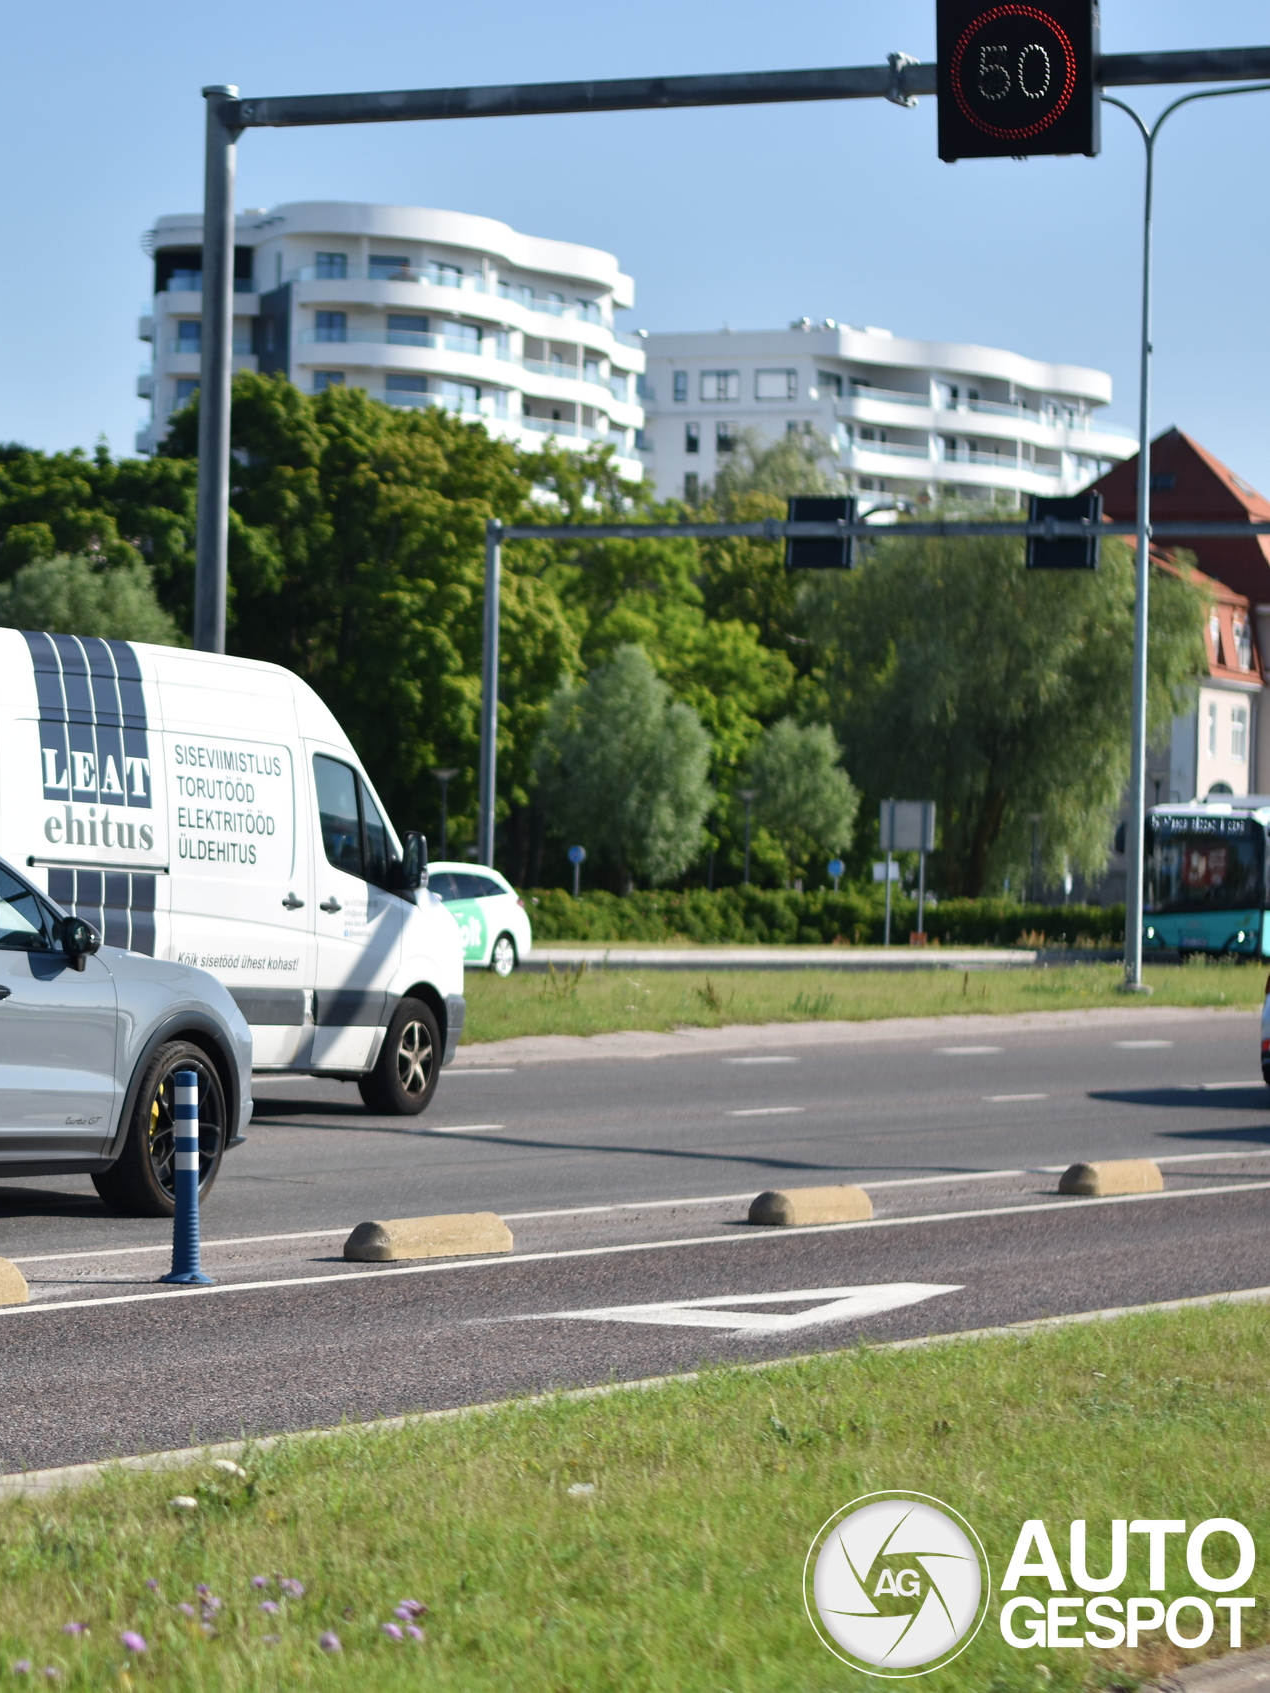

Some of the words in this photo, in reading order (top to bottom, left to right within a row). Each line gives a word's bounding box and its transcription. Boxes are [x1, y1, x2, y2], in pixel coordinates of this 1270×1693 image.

[977, 43, 1051, 101] 50
[42, 748, 150, 797] LEAT
[175, 744, 282, 777] SISEVIIMISTLUS
[176, 775, 255, 803] TORUTÖÖD
[44, 804, 154, 851] ehitus
[178, 807, 275, 836] ELEKTRITÖÖD
[179, 833, 257, 865] ÜLDEHITUS
[177, 951, 198, 967] Kõik
[200, 953, 240, 969] sisetööd
[241, 954, 267, 970] ühest
[267, 955, 299, 971] kohast!
